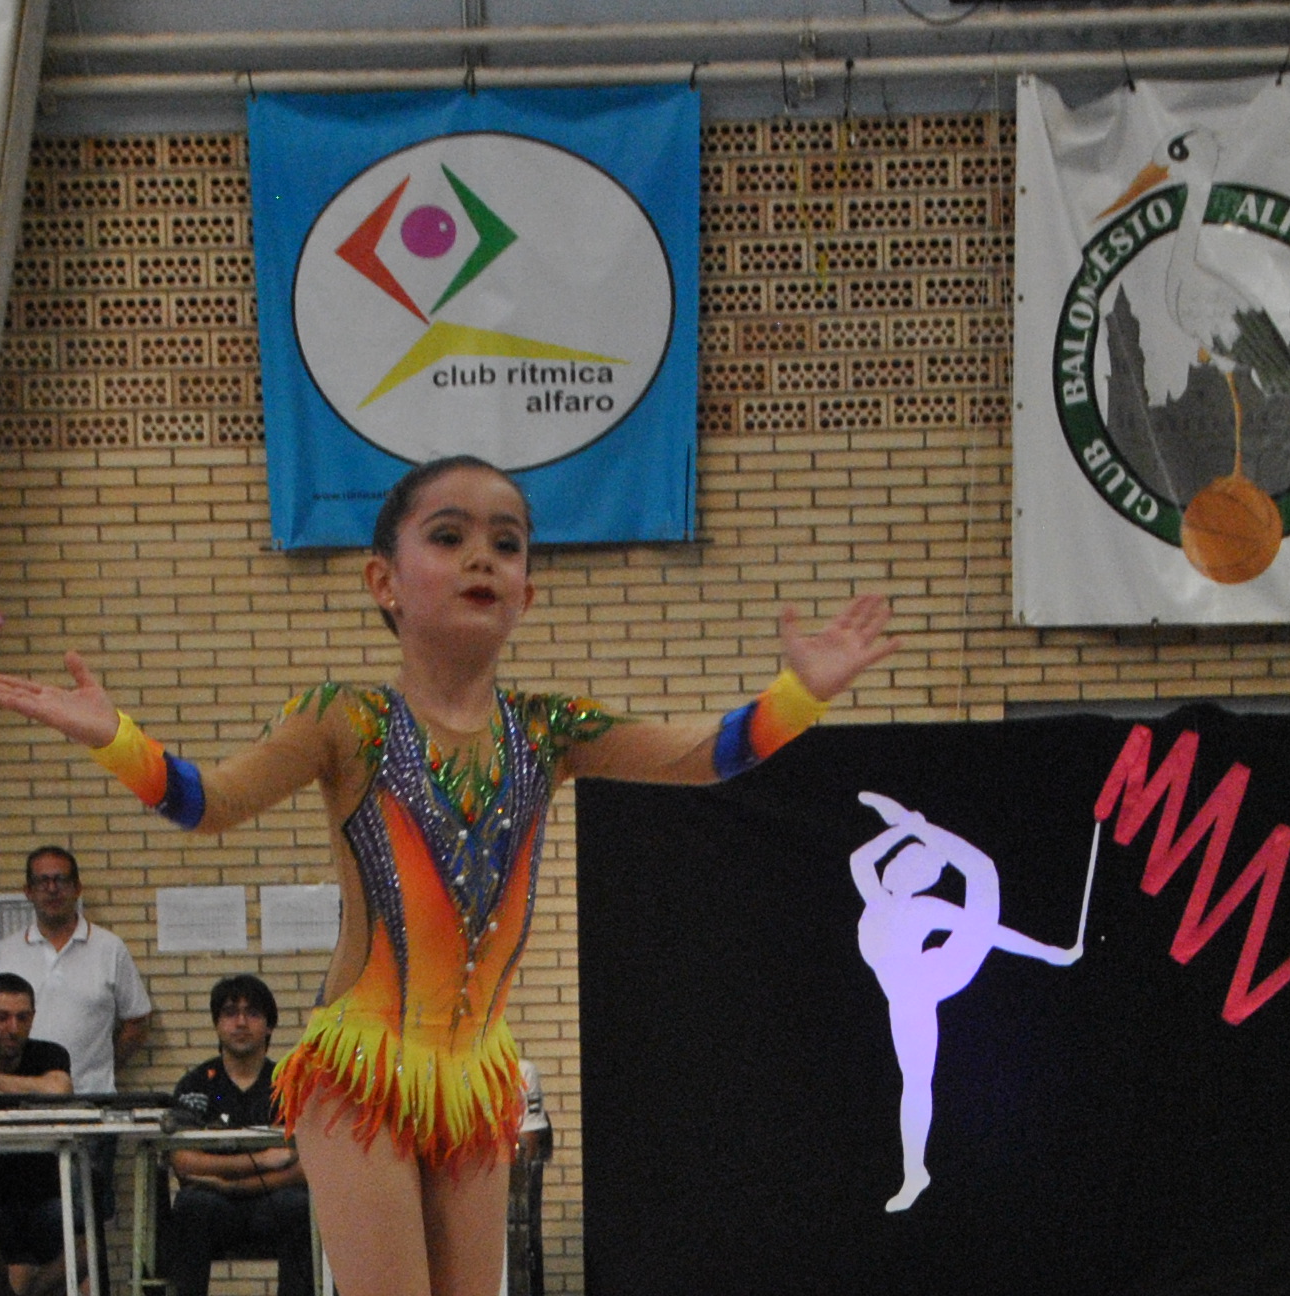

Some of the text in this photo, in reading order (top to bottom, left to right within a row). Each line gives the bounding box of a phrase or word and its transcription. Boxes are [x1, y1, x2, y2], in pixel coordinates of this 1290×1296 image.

[433, 363, 496, 387] club
[526, 390, 614, 412] alfaro
[1083, 438, 1159, 523] CLUB
